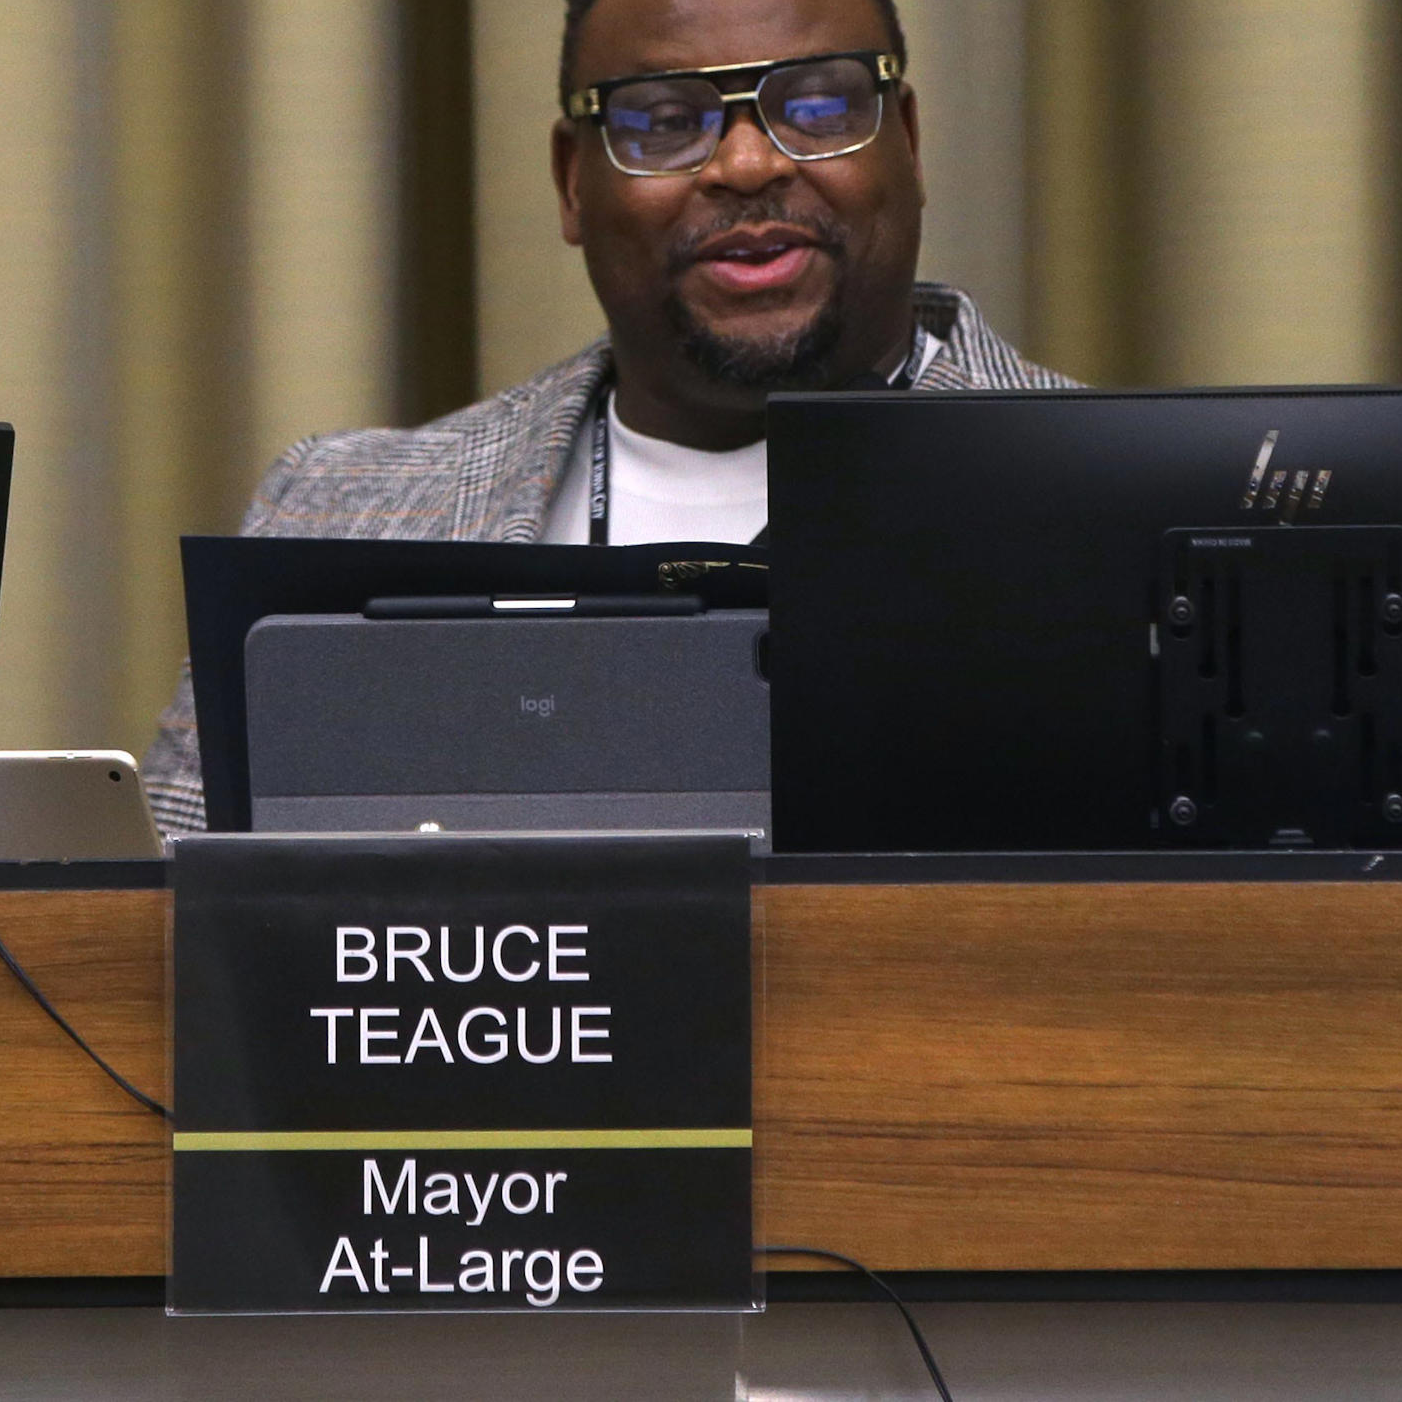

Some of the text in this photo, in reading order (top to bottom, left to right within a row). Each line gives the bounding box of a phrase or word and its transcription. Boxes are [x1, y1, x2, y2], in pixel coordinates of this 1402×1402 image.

[520, 695, 555, 717] logi
[335, 923, 591, 984] BRUCE
[309, 1006, 613, 1066] TEAGUE
[362, 1158, 568, 1226] Mayor
[319, 1235, 605, 1307] At-Large
